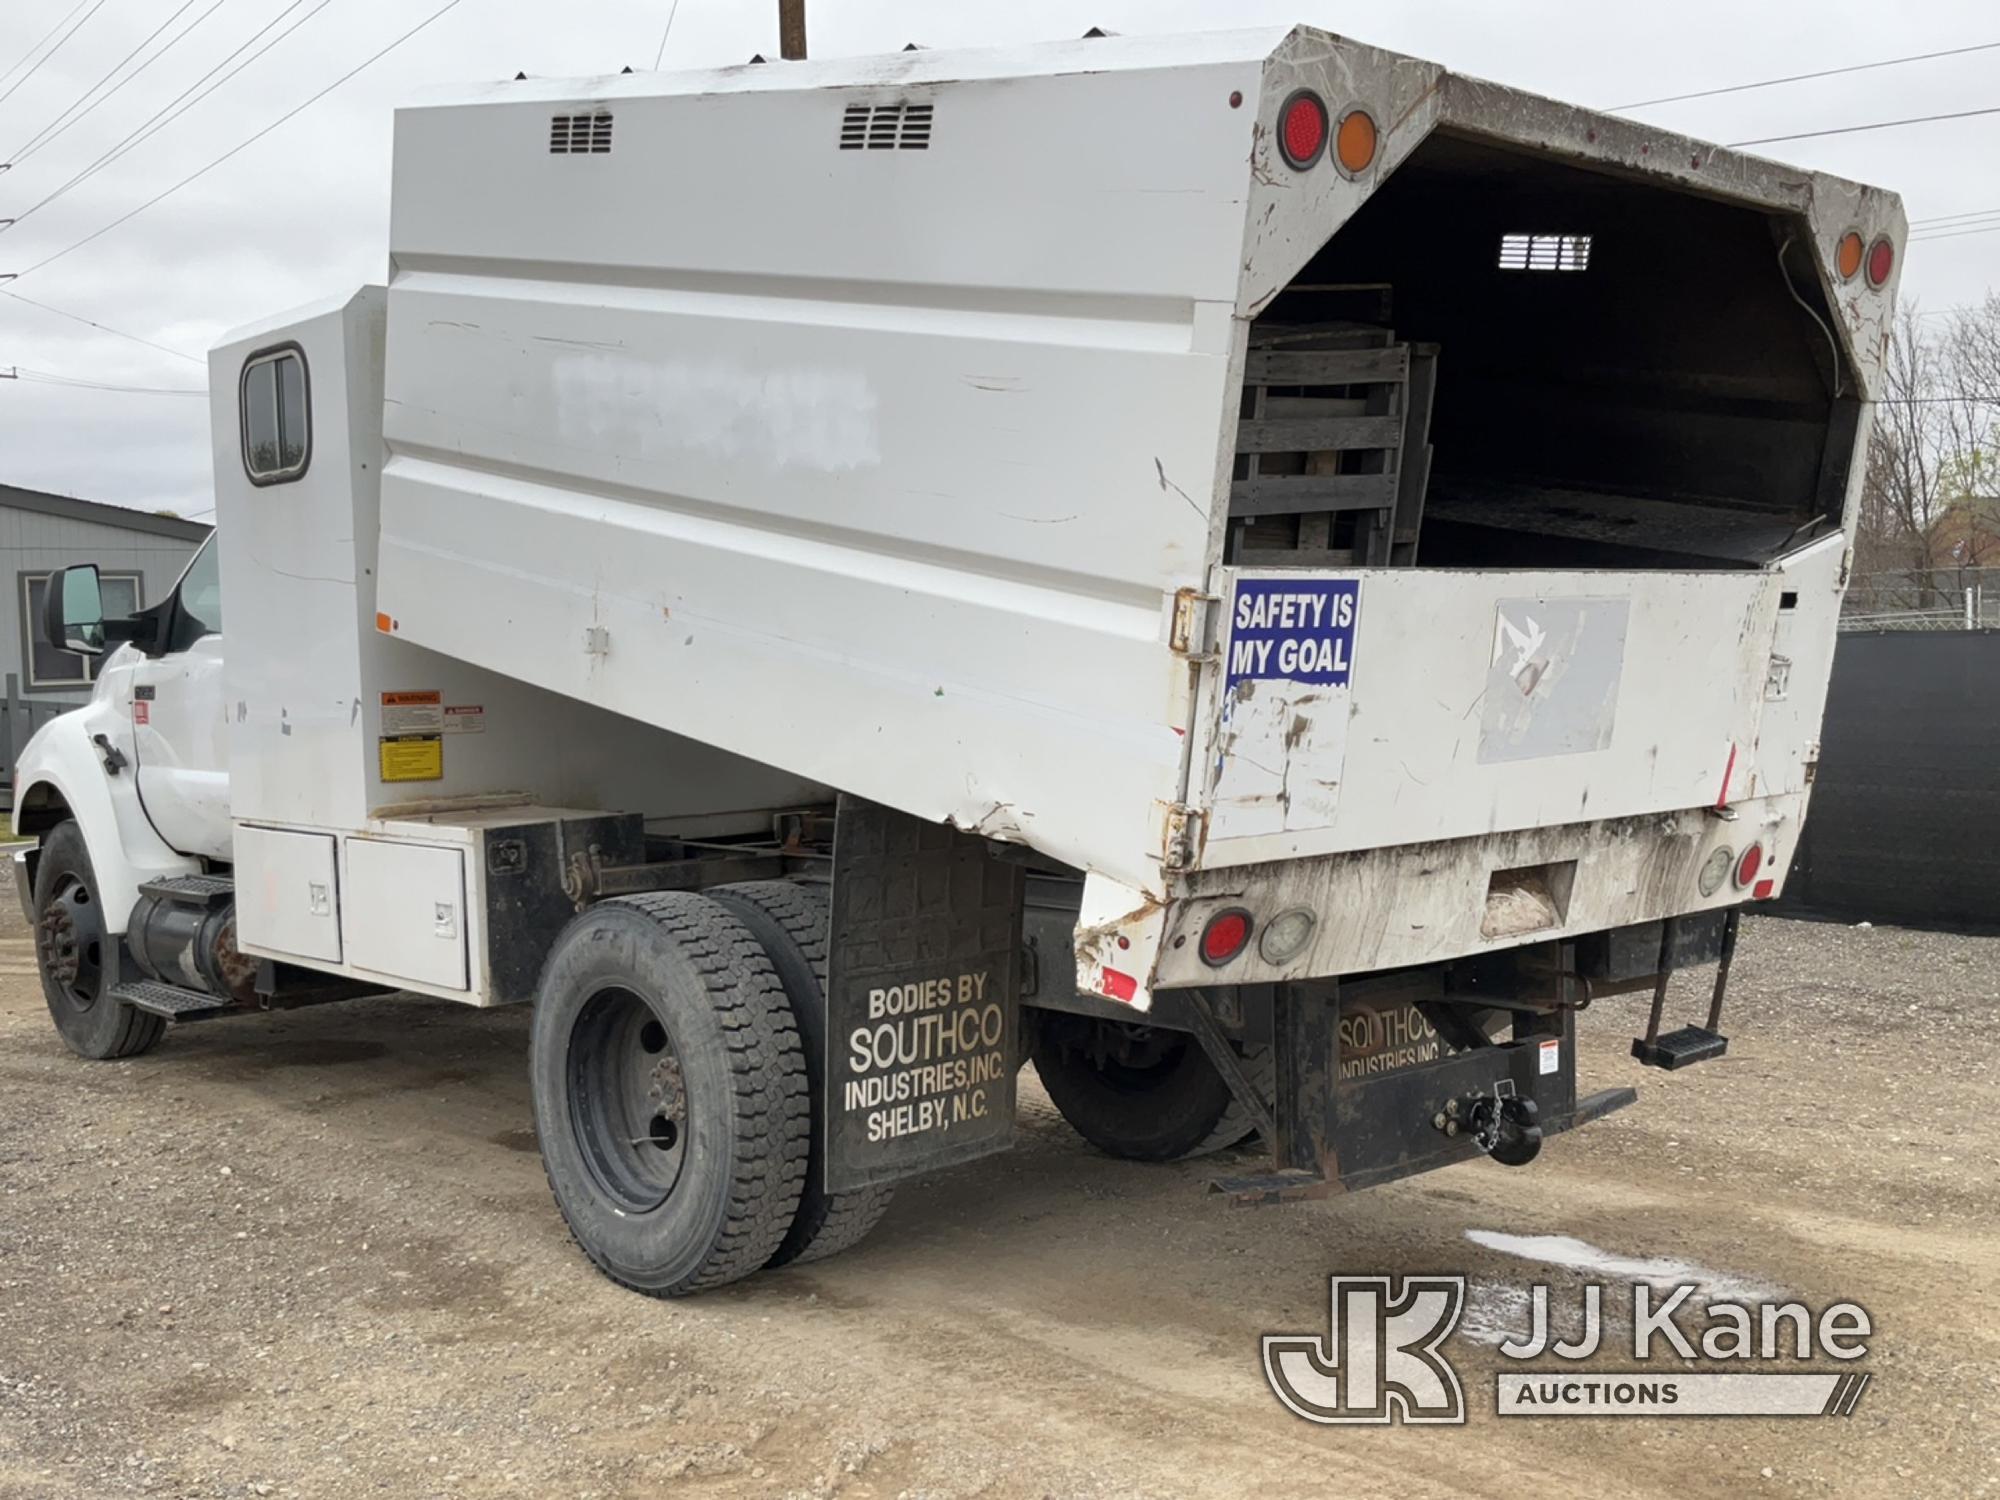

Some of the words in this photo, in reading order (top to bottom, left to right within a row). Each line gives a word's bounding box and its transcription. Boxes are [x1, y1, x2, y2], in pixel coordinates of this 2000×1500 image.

[1236, 593, 1326, 629] SAFETY
[1330, 593, 1353, 628] IS
[1231, 640, 1274, 675] MY
[1278, 638, 1348, 674] GOAL
[869, 978, 951, 1020] BODIES
[957, 971, 988, 1004] BY
[849, 1003, 1003, 1074] SOUTHCO
[867, 1097, 949, 1142] SHELBY,
[953, 1089, 988, 1123] N.C.
